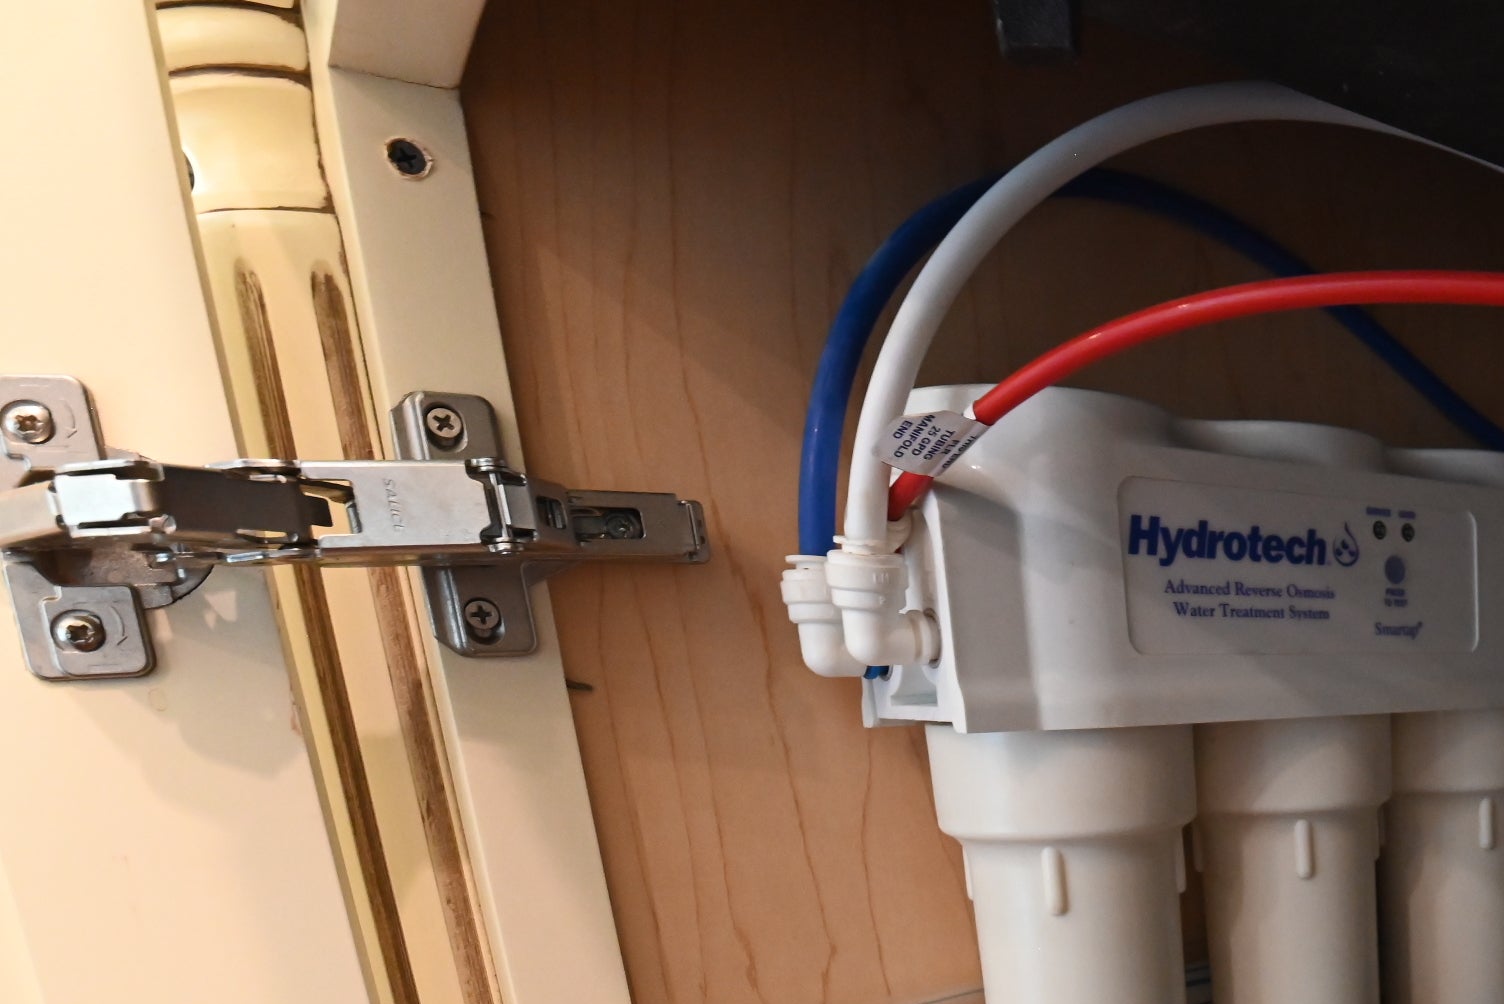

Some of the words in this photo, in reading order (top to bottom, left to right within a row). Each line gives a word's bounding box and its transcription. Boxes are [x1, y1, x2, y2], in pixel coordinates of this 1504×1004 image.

[892, 420, 913, 439] END
[893, 414, 936, 458] MANIFOLD
[928, 426, 941, 436] 25
[911, 437, 931, 456] GPD
[923, 430, 956, 460] TUBING
[1128, 514, 1326, 567] Hydrotech
[1164, 579, 1230, 596] Advanced
[1235, 581, 1283, 598] Reverse
[1287, 583, 1336, 600] Osmosis
[1173, 602, 1215, 618] Water
[1219, 603, 1285, 619] Treatment
[1289, 605, 1330, 621] System
